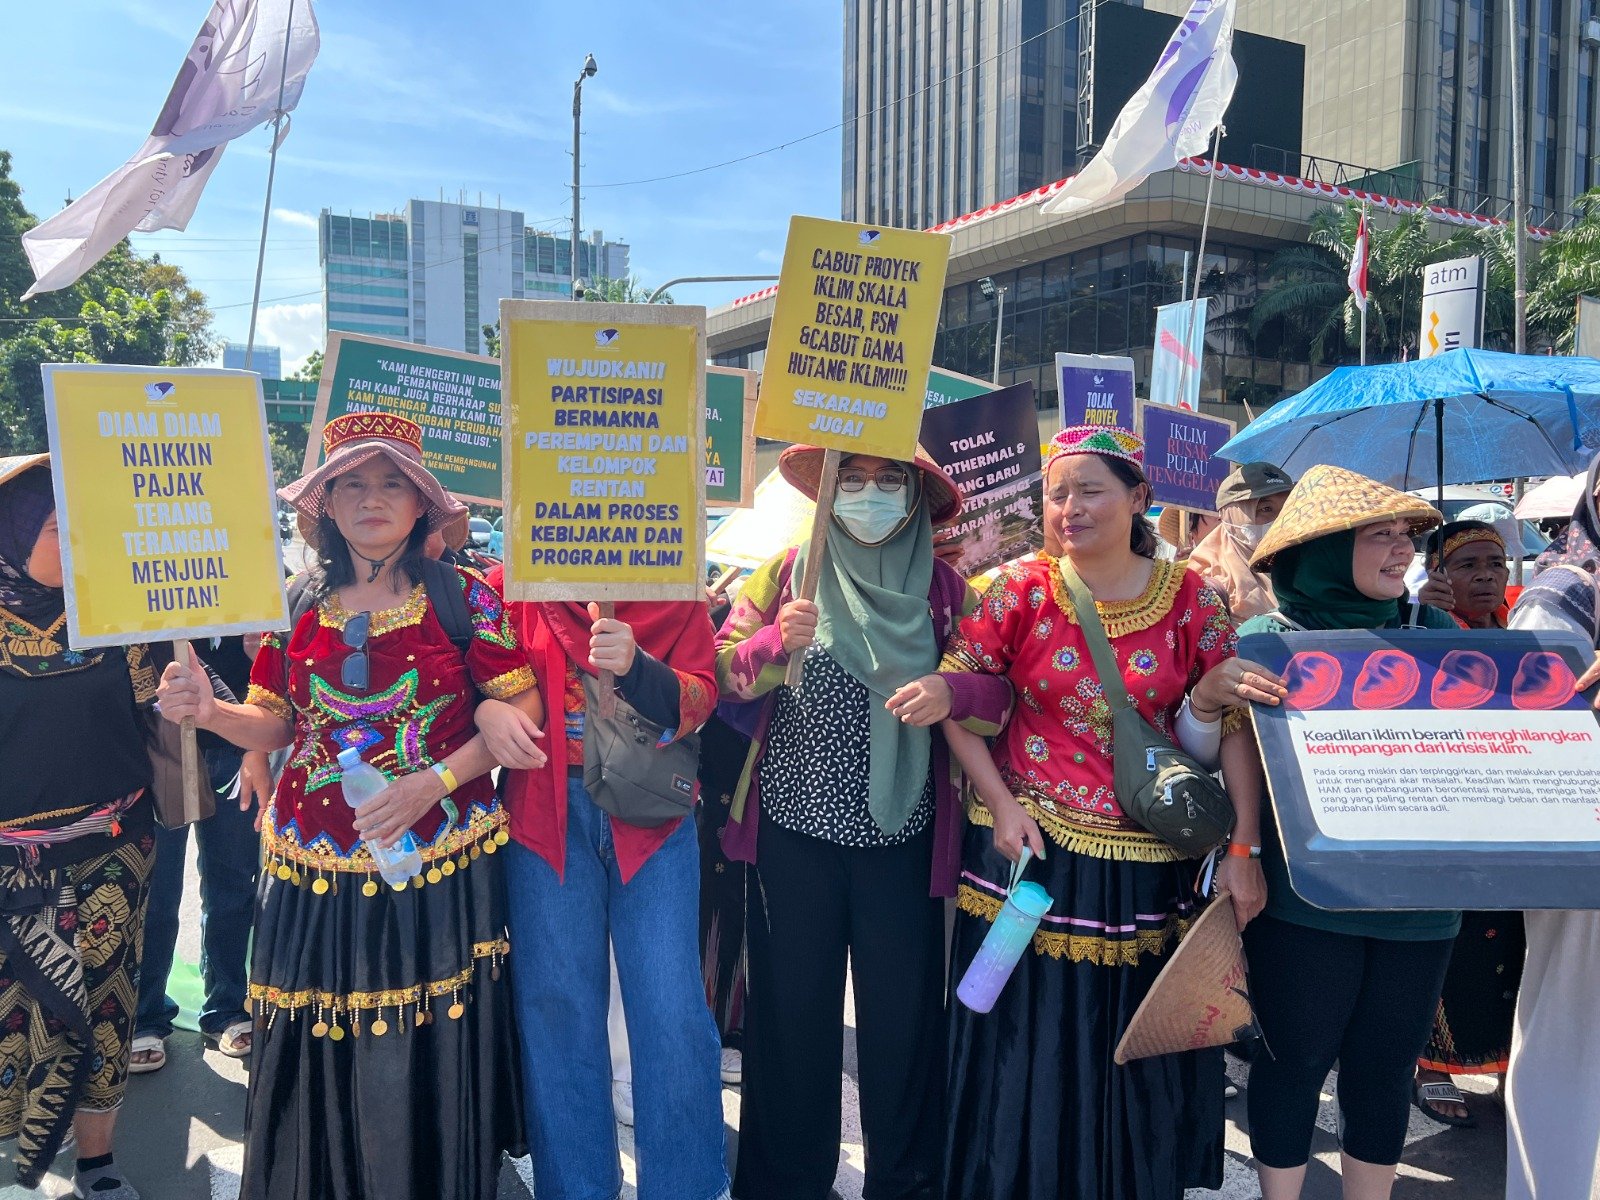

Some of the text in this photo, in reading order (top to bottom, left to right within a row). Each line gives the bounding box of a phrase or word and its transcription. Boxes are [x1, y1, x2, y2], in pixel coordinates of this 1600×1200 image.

[812, 248, 920, 282] CABUT PROYEK
[1430, 265, 1467, 285] atm
[814, 275, 907, 309] IKLIM SKALA
[815, 302, 898, 335] BESAR, PSN
[800, 326, 904, 364] &CABUT DANA
[410, 365, 459, 382] MENGERTI
[462, 374, 475, 386] INI
[547, 358, 665, 379] WUJUDKAN!!
[787, 352, 907, 392] HUTANG IKLIM!!!!
[349, 378, 502, 413] TAPI KAMI JUGA BERHARAP SU
[397, 375, 474, 398] PEMBANGUNAN,
[551, 386, 663, 405] PARTISIPASI
[348, 390, 502, 425] KAMI DIDENGAR AGAR KAMI TID
[792, 388, 887, 418] SEKARANG
[1087, 392, 1114, 408] TOLAK
[98, 411, 222, 437] DIAM DIAM
[411, 412, 451, 428] KORBAN
[554, 410, 659, 428] BERMAKNA
[706, 408, 722, 422] RA,
[808, 414, 864, 437] JUGA!
[1084, 408, 1118, 426] PROYEK
[428, 428, 452, 441] DARI
[525, 432, 687, 452] PEREMPUAN DAN
[950, 430, 996, 454] TOLAK
[1170, 423, 1206, 446] IKLIM
[121, 442, 212, 466] NAIKKIN
[422, 451, 496, 470] MPAK PEMBANGUNAN
[942, 442, 1026, 477] OTHERMAL &
[1168, 438, 1208, 462] RUSAK
[557, 456, 657, 474] KELOMPOK
[1166, 453, 1208, 476] PULAU
[132, 472, 204, 497] PAJAK
[570, 480, 644, 498] RENTAN
[958, 463, 1020, 494] ANG BARU
[134, 501, 212, 527] TERANG
[535, 502, 678, 520] DALAM PROSES
[122, 528, 229, 556] TERANGAN
[531, 526, 682, 544] KEBIJAKAN DAN
[531, 548, 682, 566] PROGRAM IKLIM!
[132, 557, 229, 584] MENJUAL
[147, 585, 220, 612] HUTAN!
[1303, 728, 1592, 744] Keadilan iklim berarti menghilangkan
[1306, 742, 1532, 756] ketimpangan dari krisis iklim.
[1314, 768, 1336, 776] Pada
[1486, 768, 1502, 776] dan
[1506, 768, 1556, 776] melakukan
[1558, 769, 1600, 777] perubaha
[1345, 777, 1396, 785] menangani
[1532, 778, 1600, 787] menghubungk
[1318, 786, 1340, 794] HAM
[1344, 786, 1362, 794] dan
[1365, 786, 1432, 794] pembangunan
[1435, 786, 1489, 794] berorientasi
[1537, 787, 1576, 795] menjaga
[1579, 787, 1600, 795] hak-
[1321, 796, 1348, 804] orang
[1377, 795, 1406, 804] paling
[1442, 795, 1460, 803] dan
[1462, 796, 1506, 805] membagi
[1508, 796, 1538, 804] beban
[1541, 796, 1559, 804] dan
[1324, 805, 1374, 814] perubahan
[1375, 804, 1396, 812] iklim
[1427, 1087, 1459, 1096] MILANO
